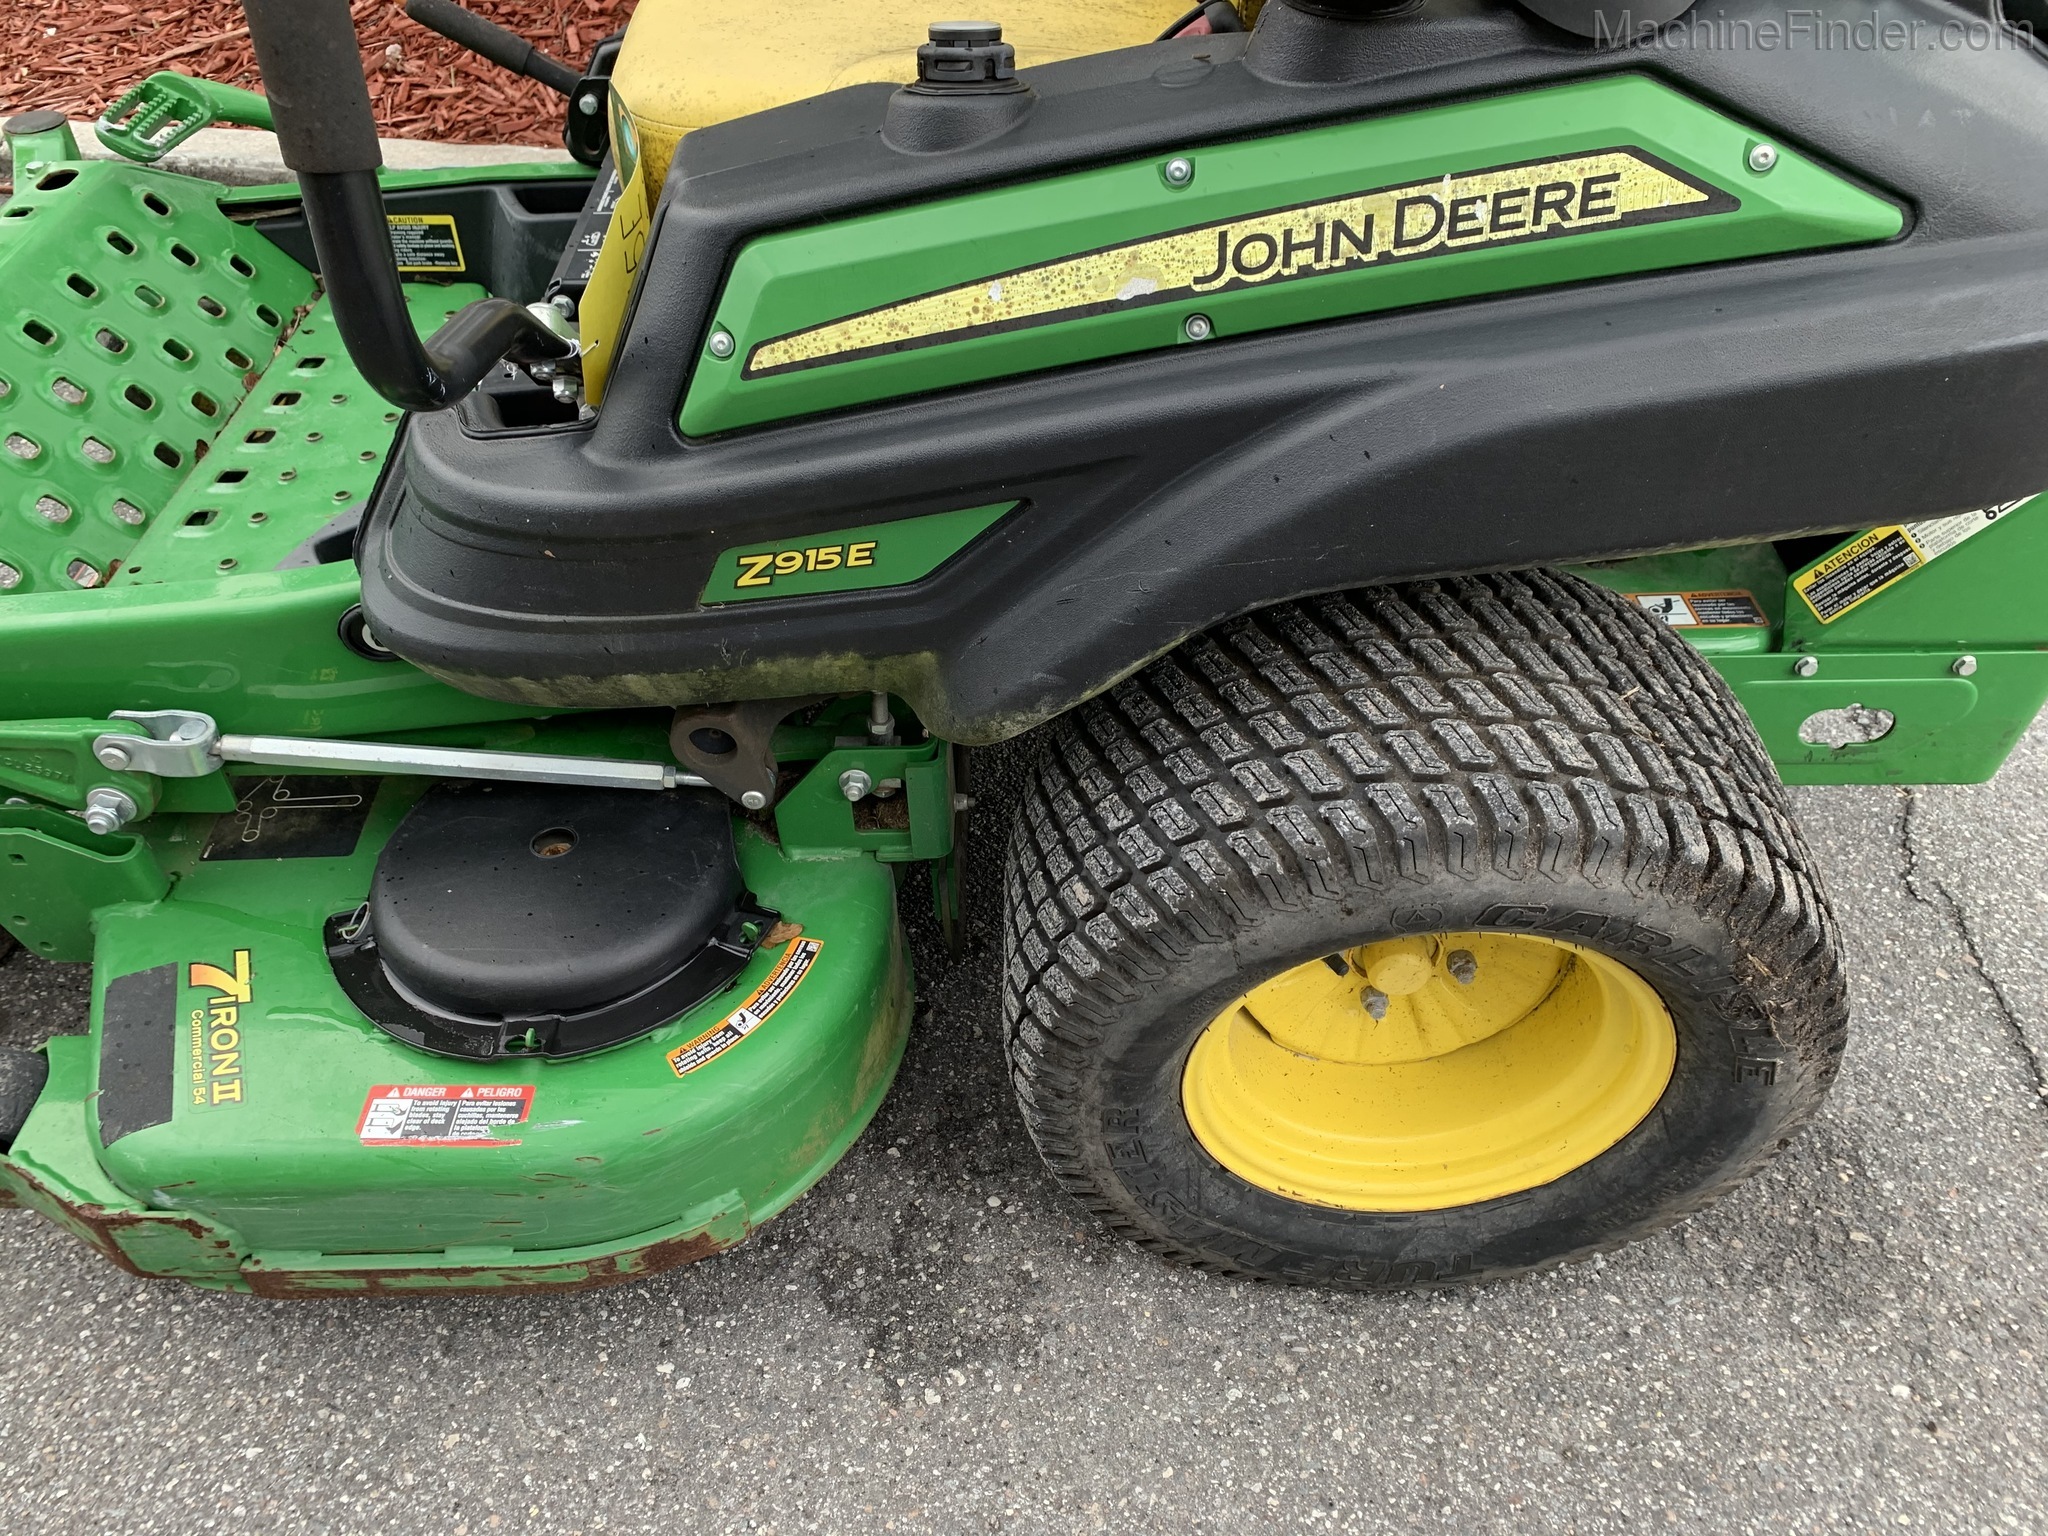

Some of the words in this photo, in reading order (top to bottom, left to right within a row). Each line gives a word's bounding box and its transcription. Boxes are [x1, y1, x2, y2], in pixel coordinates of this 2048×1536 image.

[1193, 213, 1375, 286] JOHN
[1393, 173, 1620, 249] DEERE
[734, 540, 878, 589] Z915E
[1822, 533, 1879, 573] ATENCION
[190, 1009, 206, 1084] Commercial
[687, 1026, 720, 1048] WARNING
[192, 1087, 206, 1105] 54
[403, 1088, 447, 1097] DANGER
[476, 1088, 522, 1097] PELIGRO
